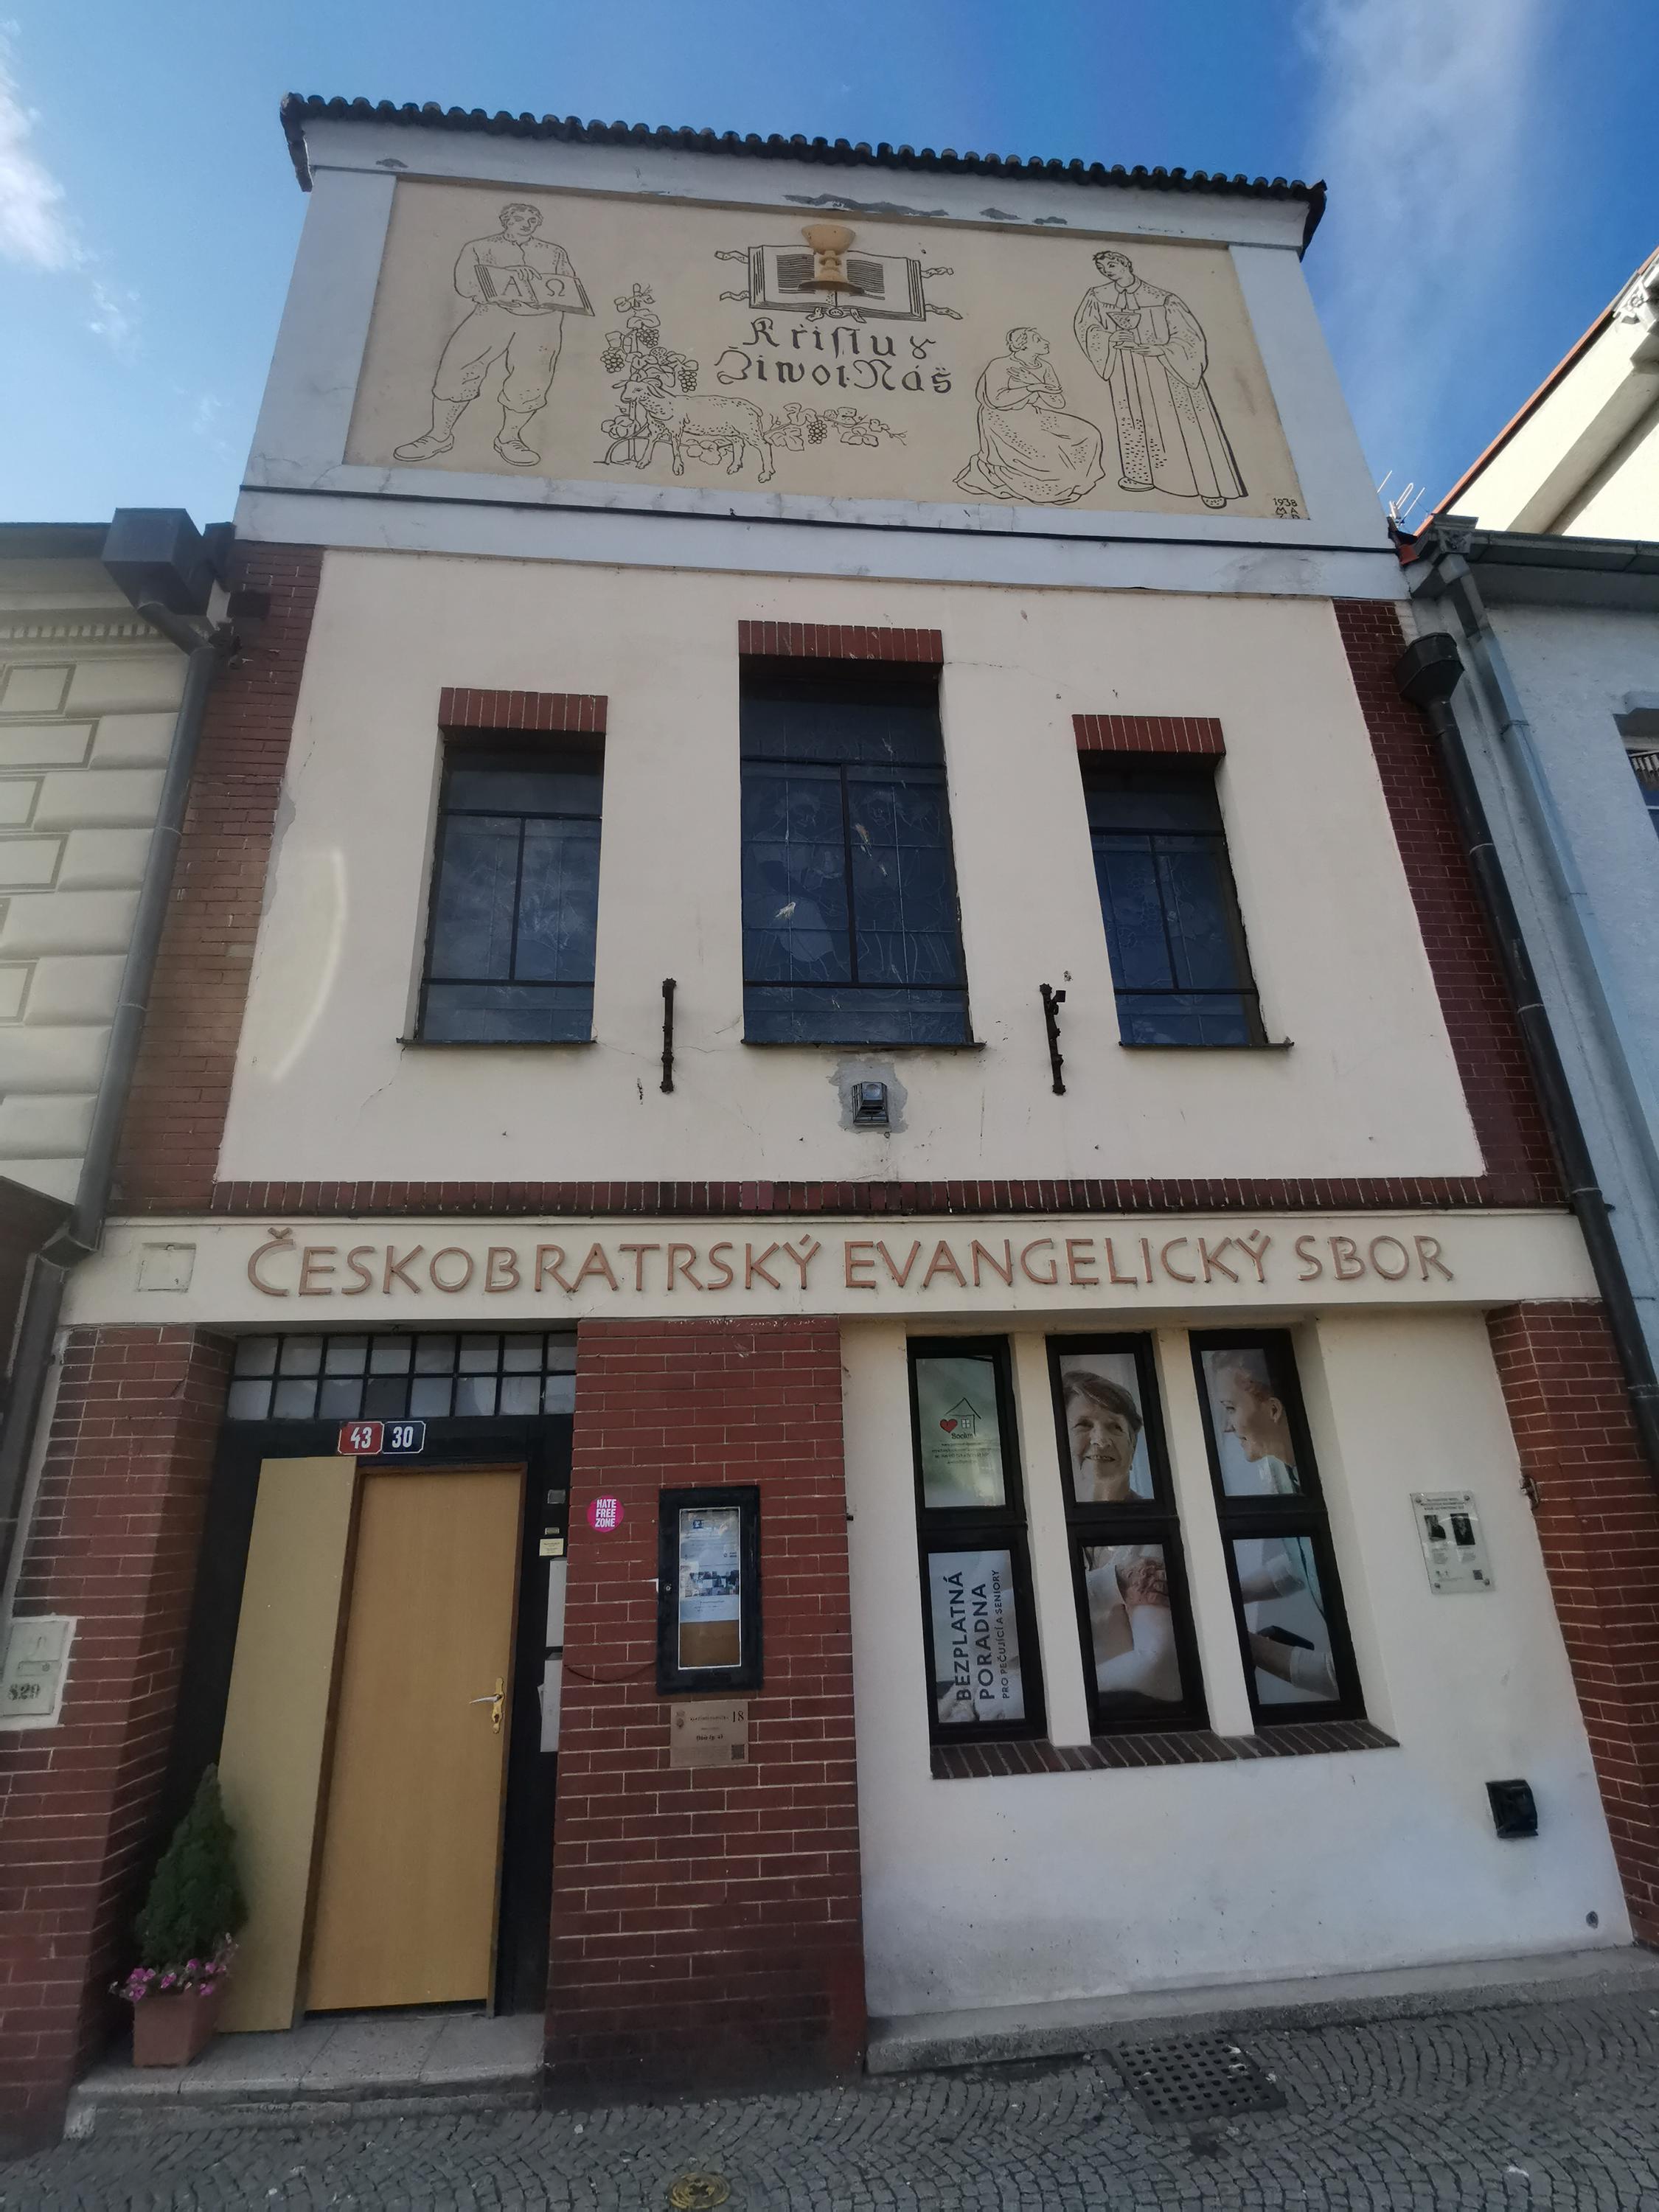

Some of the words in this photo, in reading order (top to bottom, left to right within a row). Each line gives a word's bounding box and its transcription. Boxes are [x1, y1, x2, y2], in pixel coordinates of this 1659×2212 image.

[1273, 498, 1298, 507] 1938
[247, 1226, 821, 1296] ČESKOBRATRSKÝ
[844, 1229, 1272, 1290] EVANGELICKÝ
[1295, 1234, 1455, 1281] SBOR
[350, 1427, 372, 1450] 43
[392, 1426, 414, 1448] 30
[596, 1508, 616, 1518] FREE
[597, 1498, 617, 1509] HATE
[594, 1517, 616, 1528] ZONE
[991, 1569, 1004, 1614] SENIORY
[997, 1617, 1004, 1626] A
[942, 1571, 972, 1701] BEZPLATNÁ
[971, 1583, 995, 1700] PORADNA
[1001, 1678, 1010, 1700] PRO
[732, 1710, 744, 1722] 18
